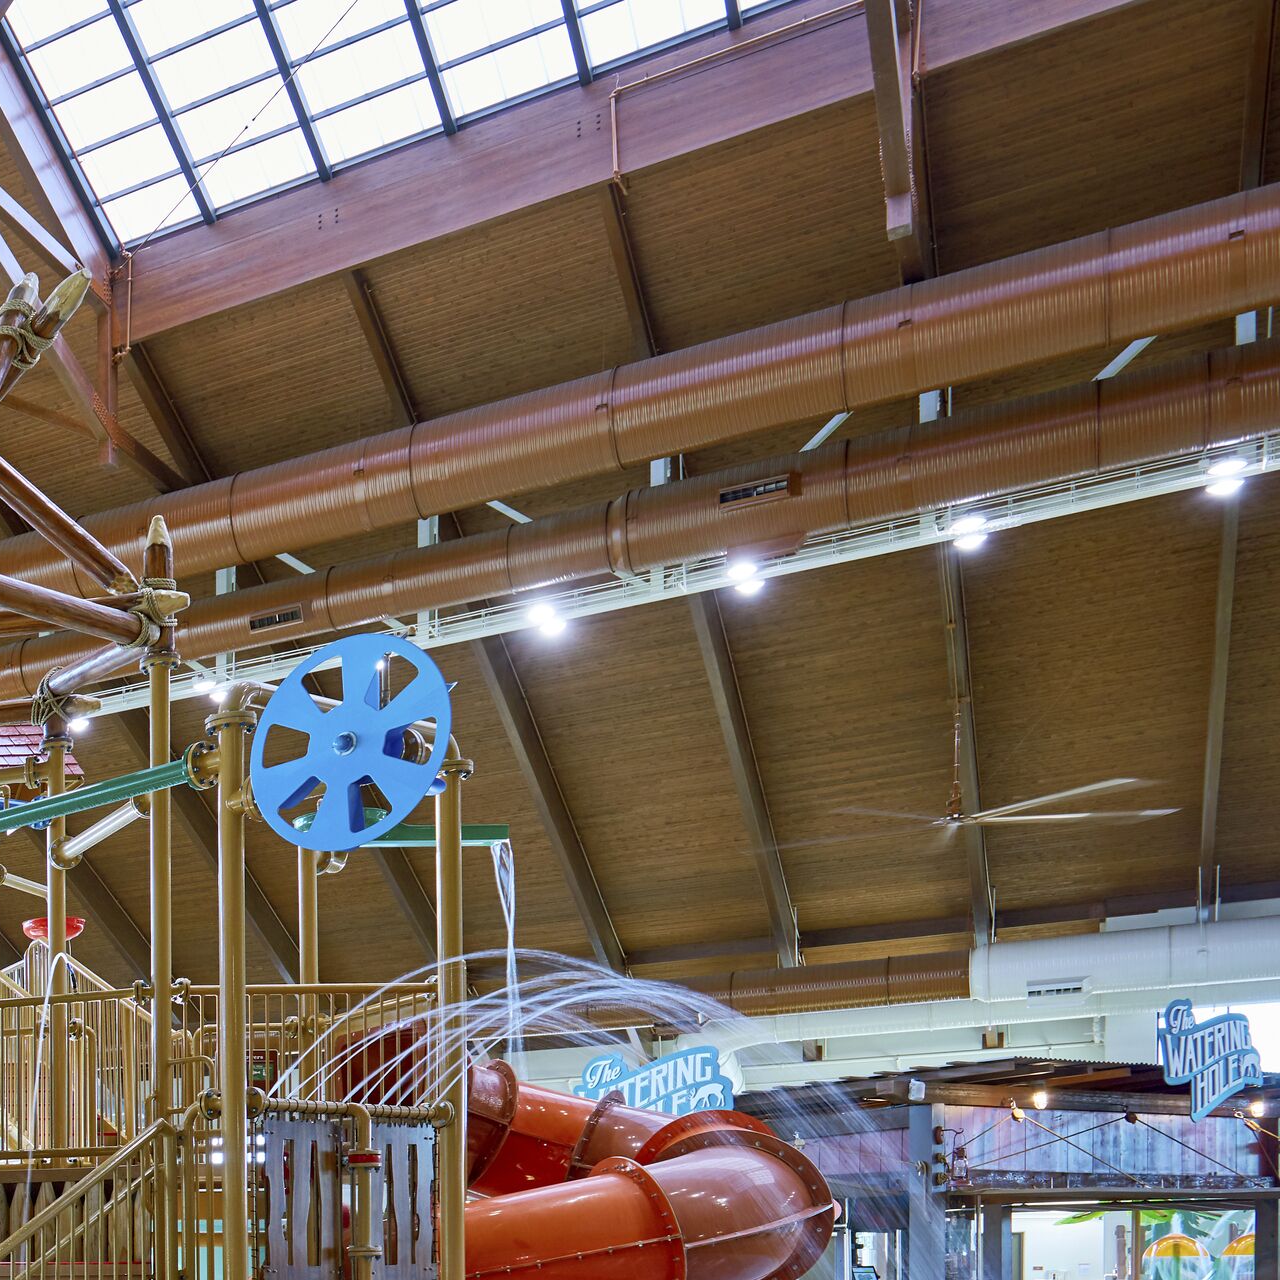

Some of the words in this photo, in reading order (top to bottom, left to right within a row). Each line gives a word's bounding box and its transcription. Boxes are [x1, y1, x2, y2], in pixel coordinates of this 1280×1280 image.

[1170, 1005, 1195, 1034] The
[586, 1058, 621, 1088] The
[1166, 1020, 1252, 1078] WATERING
[578, 1052, 712, 1107] TERING
[1196, 1054, 1241, 1114] HOLE
